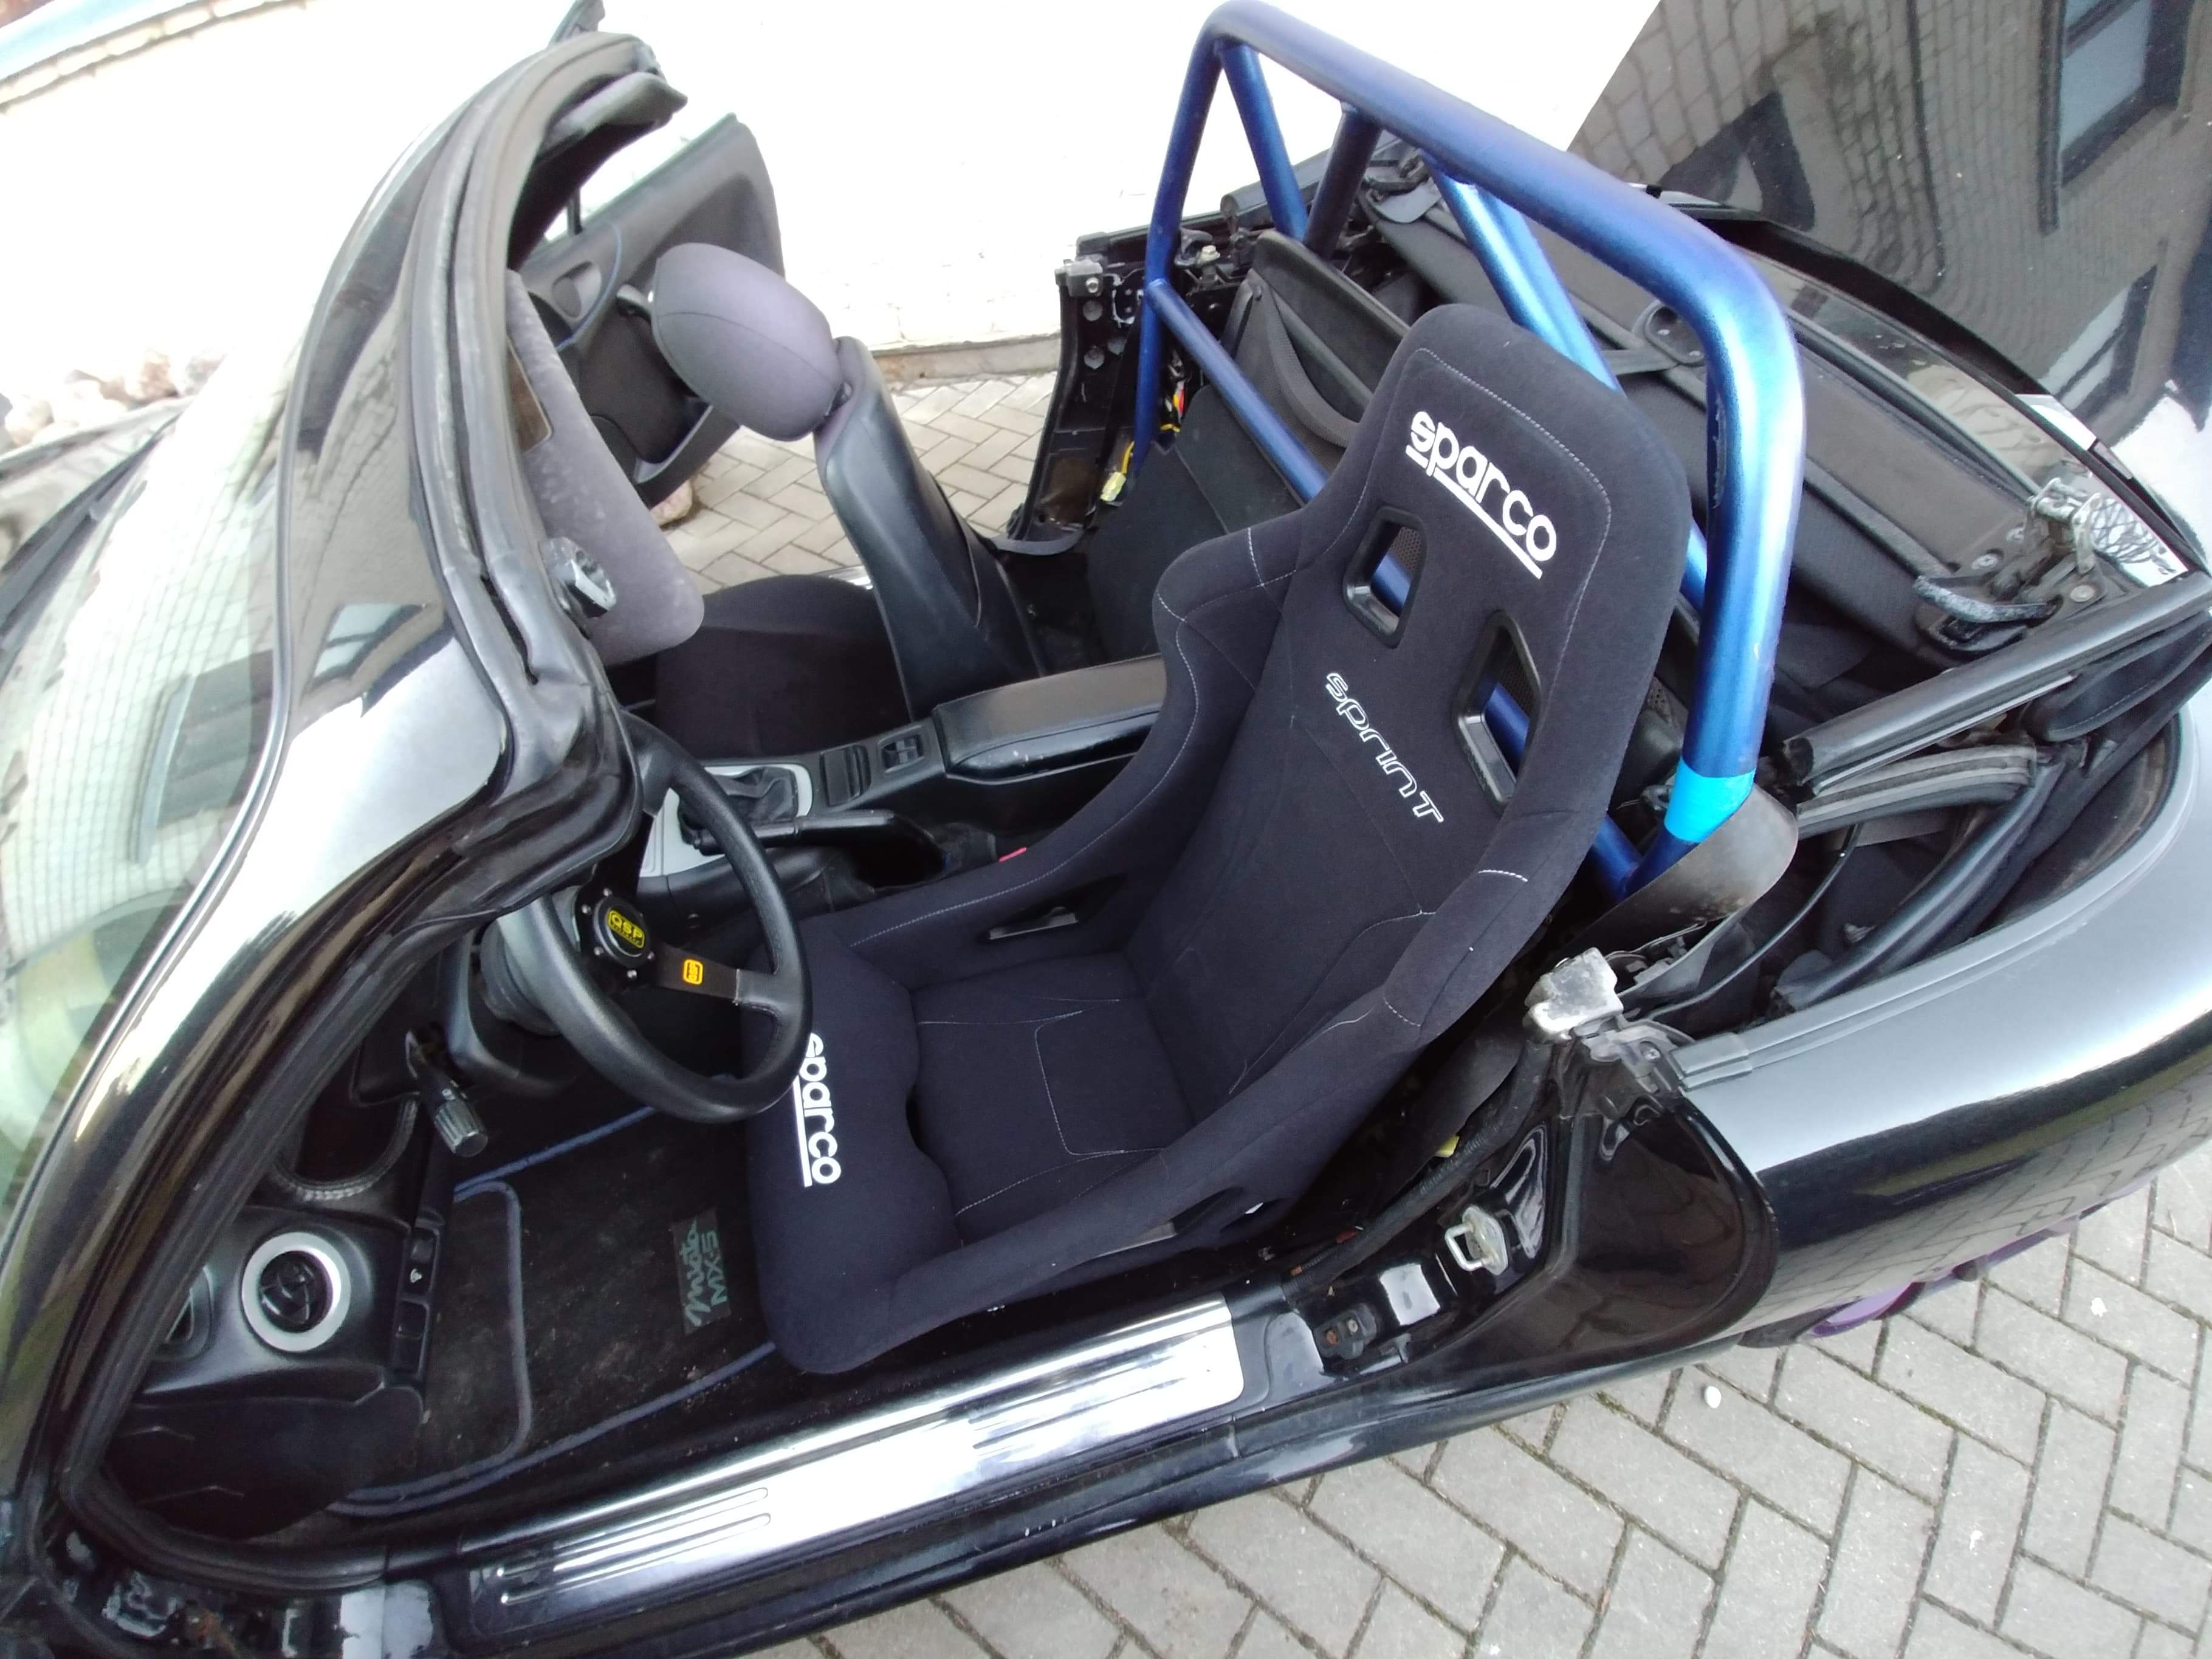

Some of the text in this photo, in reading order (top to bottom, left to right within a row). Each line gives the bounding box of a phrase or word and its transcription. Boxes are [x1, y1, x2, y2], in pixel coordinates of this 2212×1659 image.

[1410, 411, 1557, 562] sparco
[611, 914, 642, 938] QSP
[698, 1230, 728, 1307] MX-5
